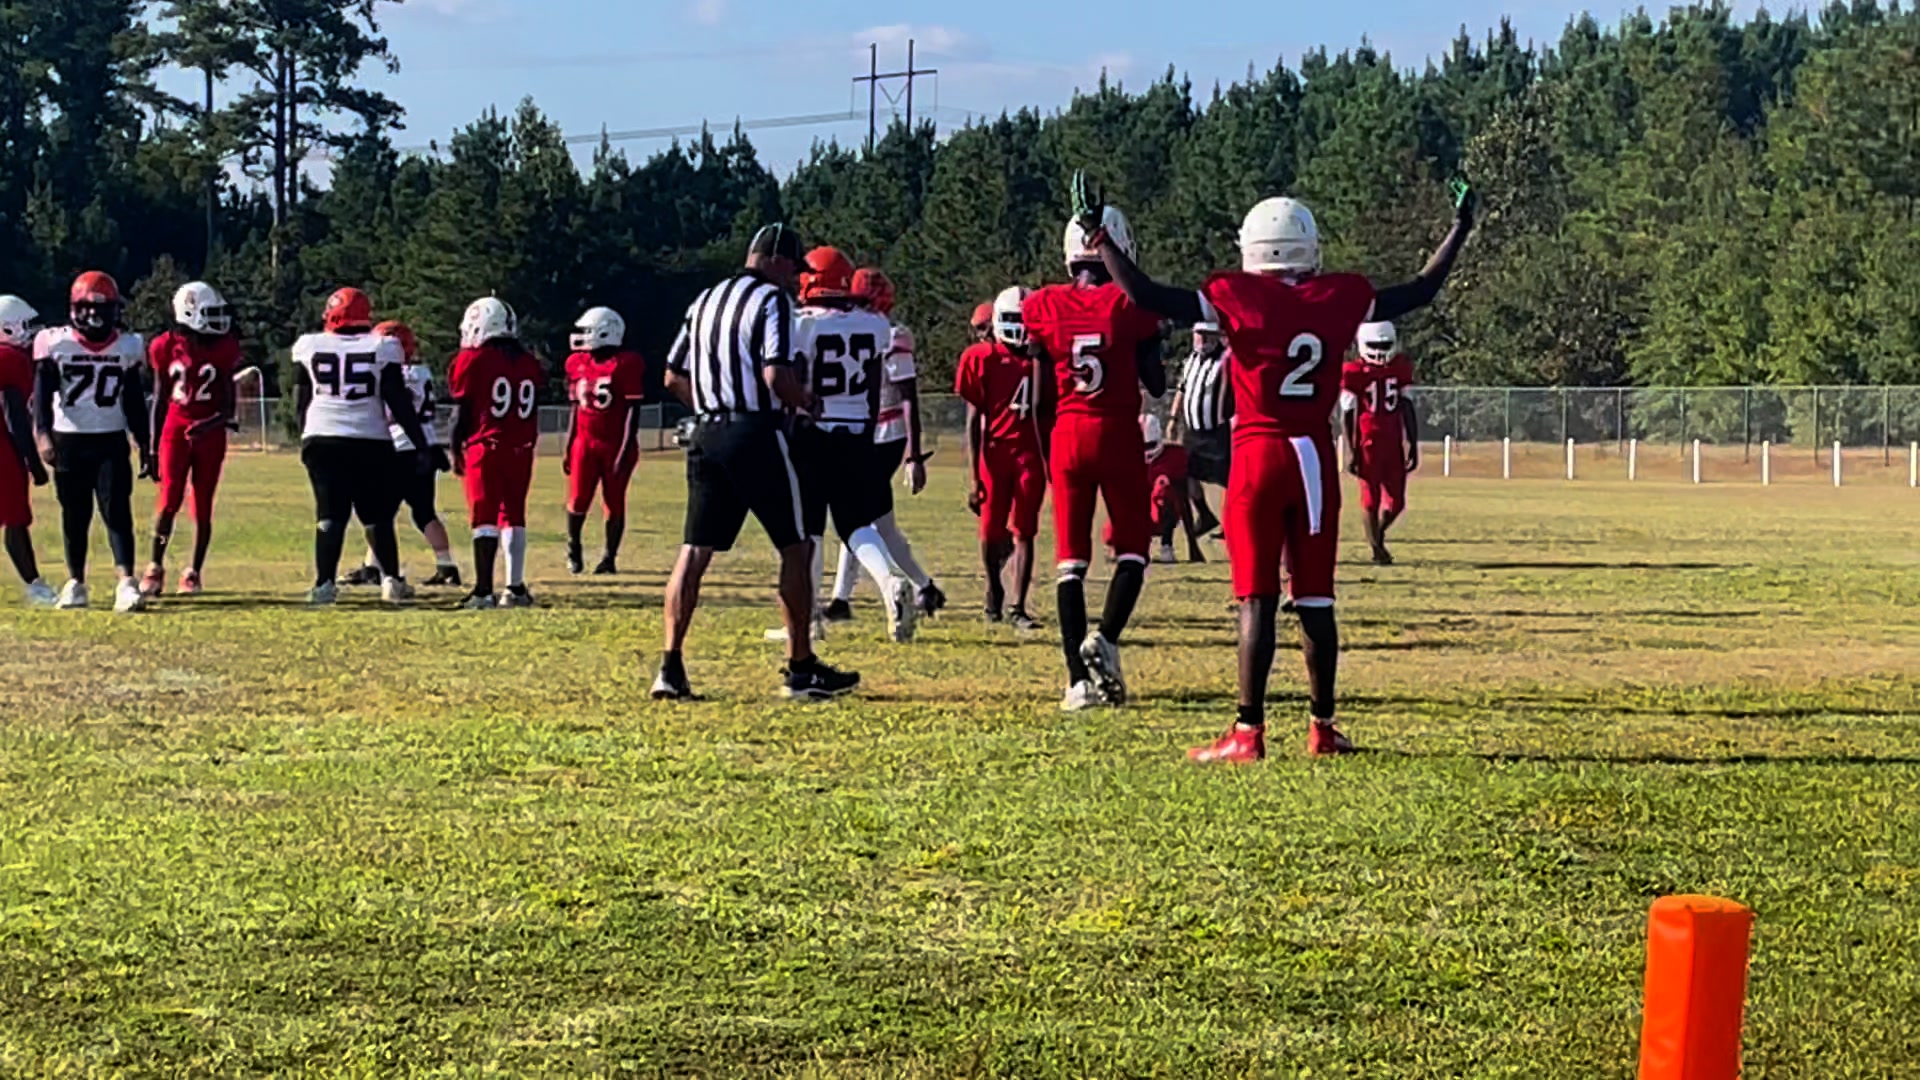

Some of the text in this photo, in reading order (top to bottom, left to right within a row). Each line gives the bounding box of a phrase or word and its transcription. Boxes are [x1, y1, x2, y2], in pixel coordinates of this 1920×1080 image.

[62, 363, 123, 408] 70
[311, 352, 377, 400] 95
[1072, 334, 1104, 394] 5
[1279, 332, 1323, 396] 2
[490, 376, 536, 420] 99
[1008, 375, 1030, 420] 4
[1365, 377, 1398, 413] 15
